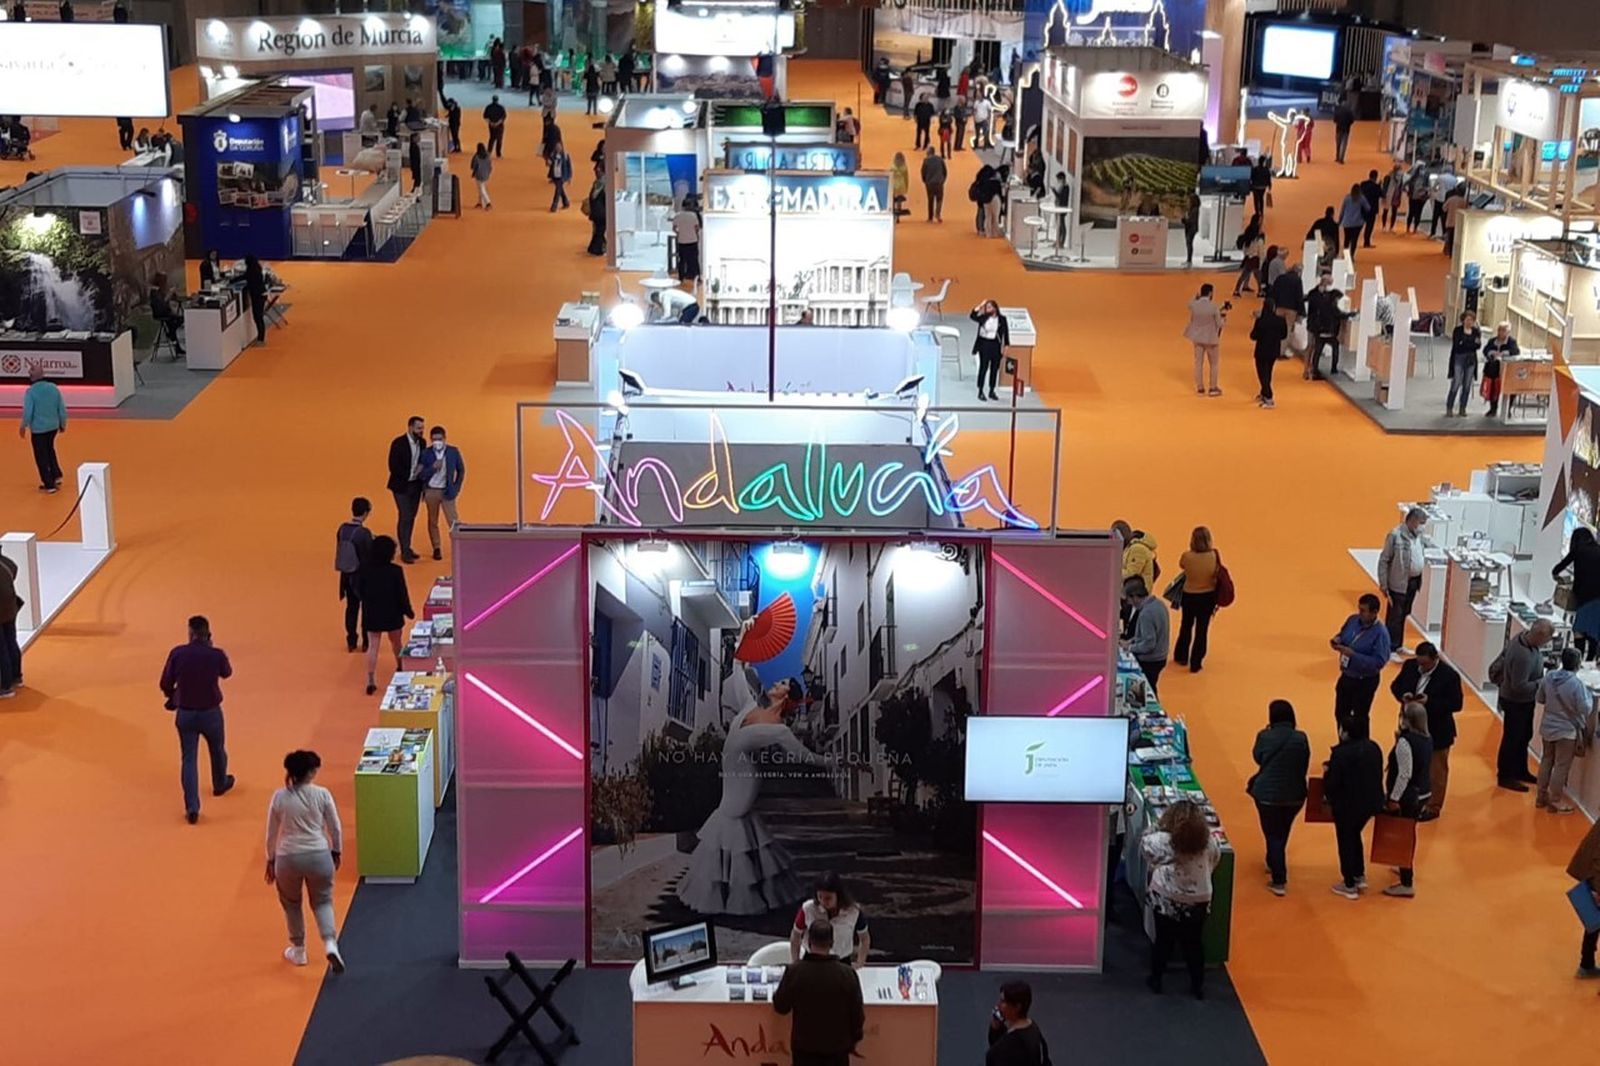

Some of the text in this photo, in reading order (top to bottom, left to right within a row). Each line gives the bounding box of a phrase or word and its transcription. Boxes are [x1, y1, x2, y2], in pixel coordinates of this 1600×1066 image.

[331, 25, 354, 46] de
[360, 23, 424, 46] Murcia
[531, 408, 1041, 528] Andalucía
[658, 751, 686, 763] NO
[694, 751, 729, 763] HAY
[824, 749, 913, 766] PEQUEÑA
